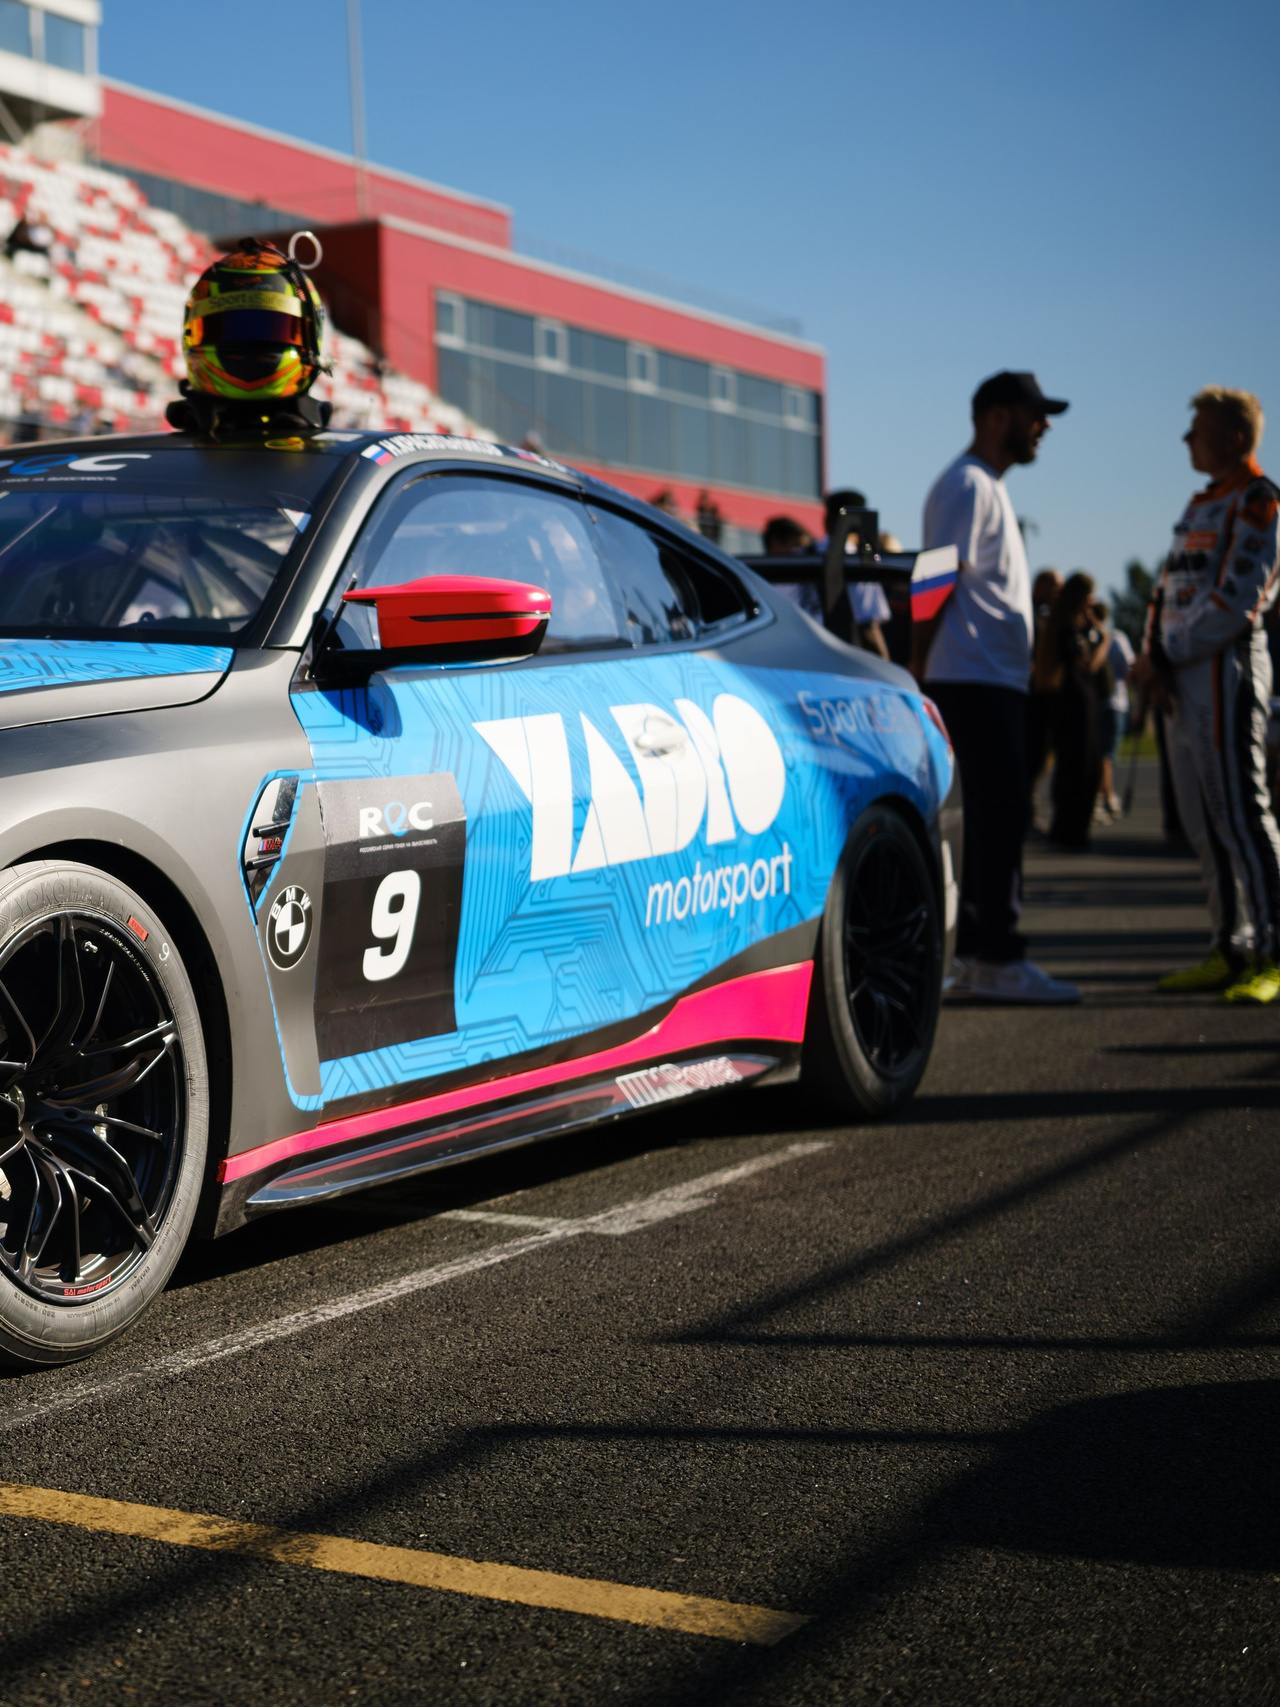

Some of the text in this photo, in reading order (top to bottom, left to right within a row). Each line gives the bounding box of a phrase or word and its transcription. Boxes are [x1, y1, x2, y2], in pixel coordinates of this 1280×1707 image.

[362, 869, 421, 982] 9
[646, 842, 793, 928] motorsport
[76, 1275, 112, 1296] motorsport
